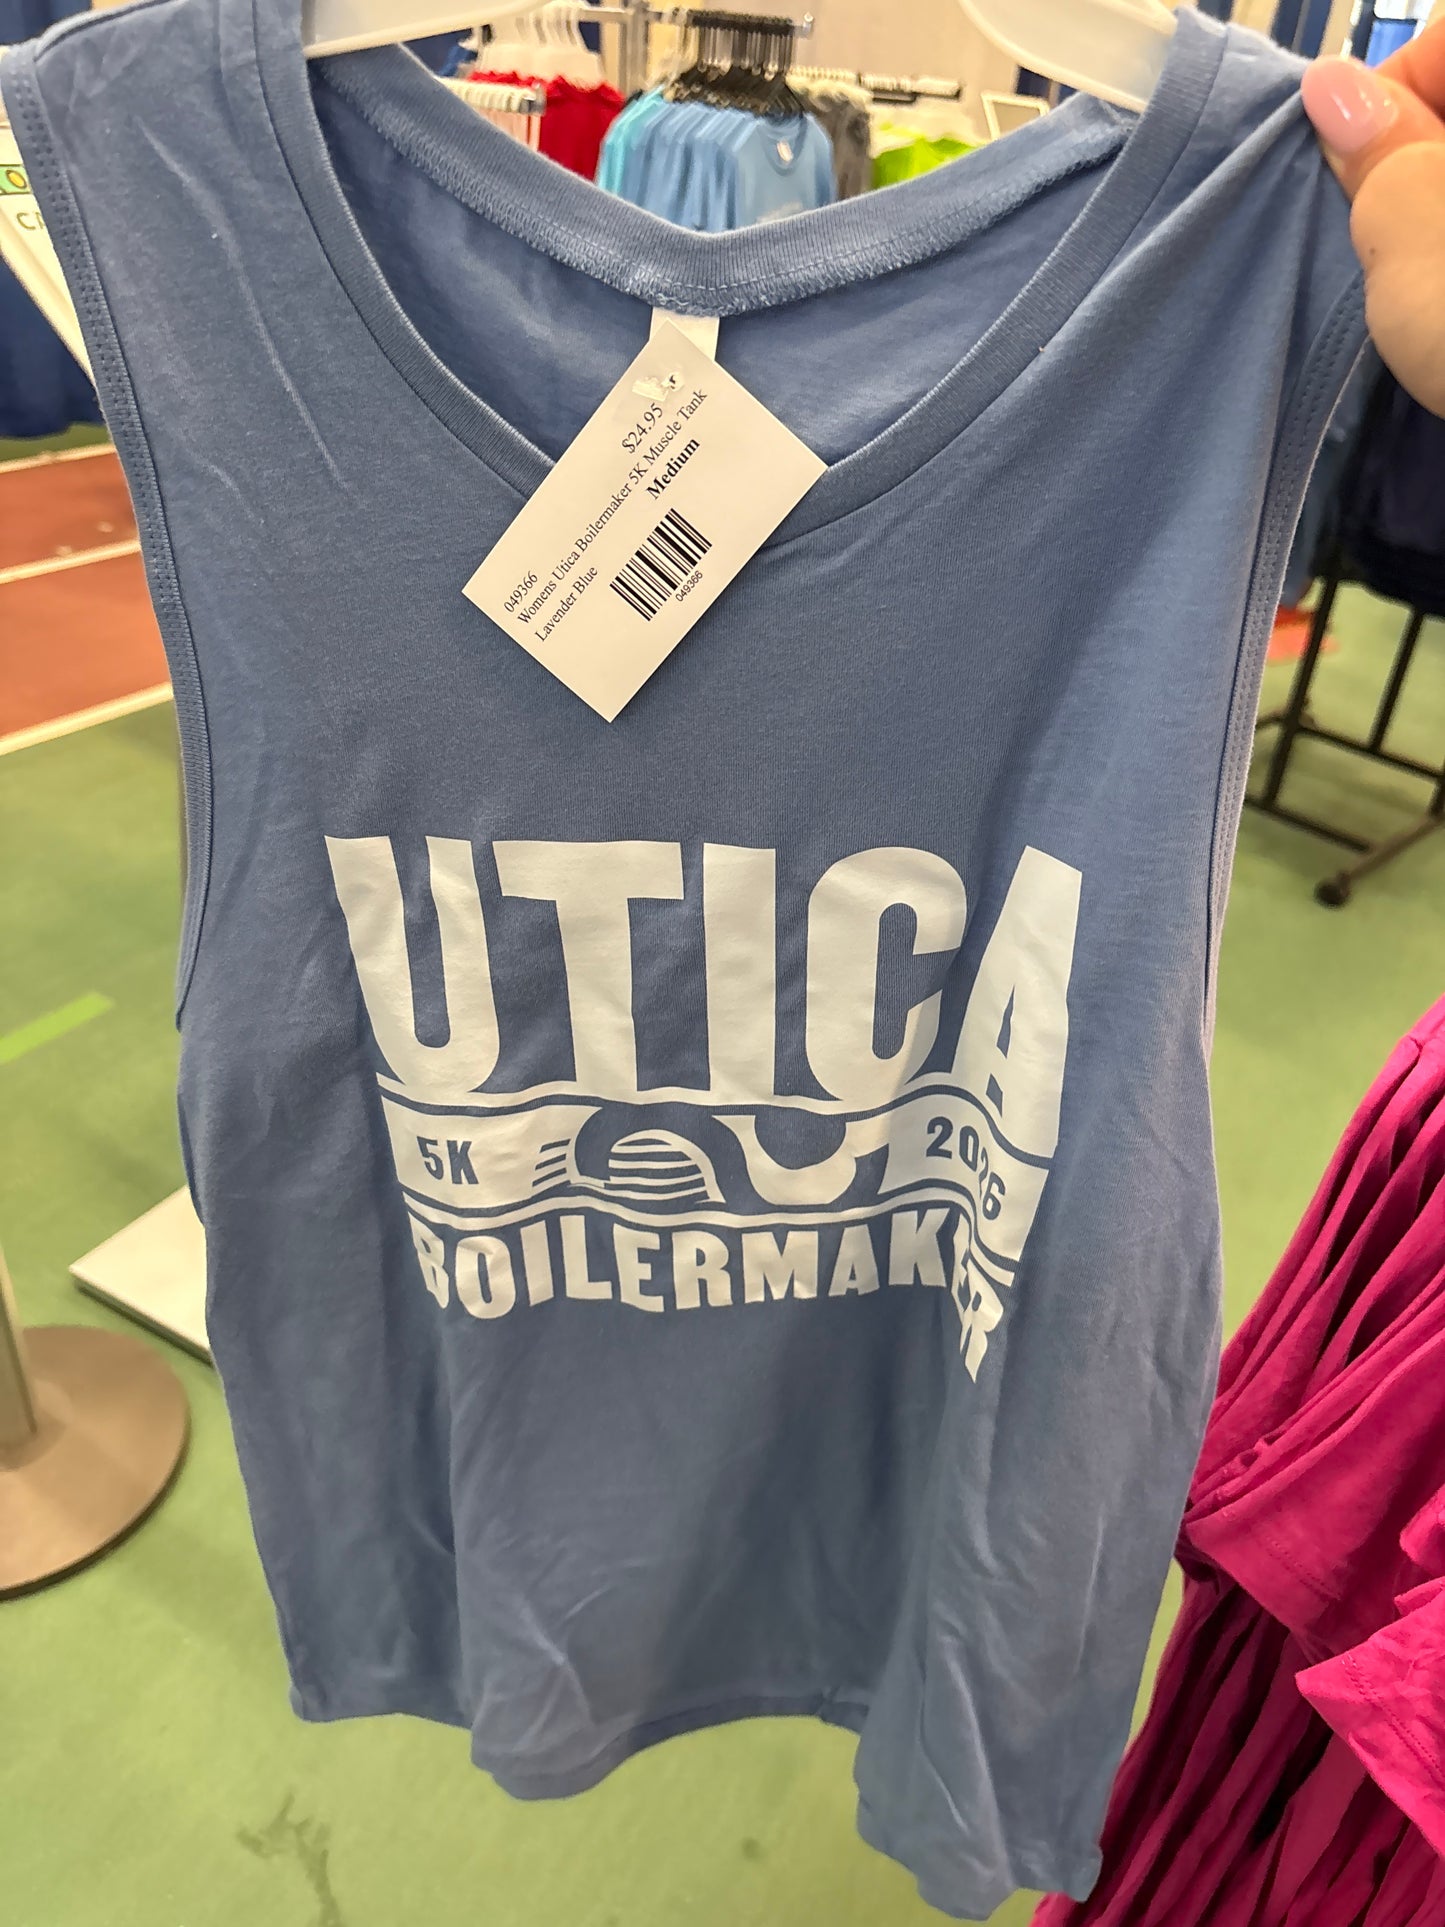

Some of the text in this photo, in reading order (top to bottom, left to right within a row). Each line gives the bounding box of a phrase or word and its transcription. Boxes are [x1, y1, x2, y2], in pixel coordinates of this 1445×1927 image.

[621, 402, 663, 454] $24.95
[517, 389, 708, 624] Womens Utica Boilermaker 5K Muscle Tank
[646, 439, 700, 500] Medium
[503, 570, 538, 613] 049366
[534, 566, 598, 642] Lavender Blue
[675, 570, 703, 602] 049366
[324, 835, 1082, 1158] UTICA
[419, 1115, 1007, 1221] 5K 2026
[408, 1207, 1004, 1384] BOILERMAKER
